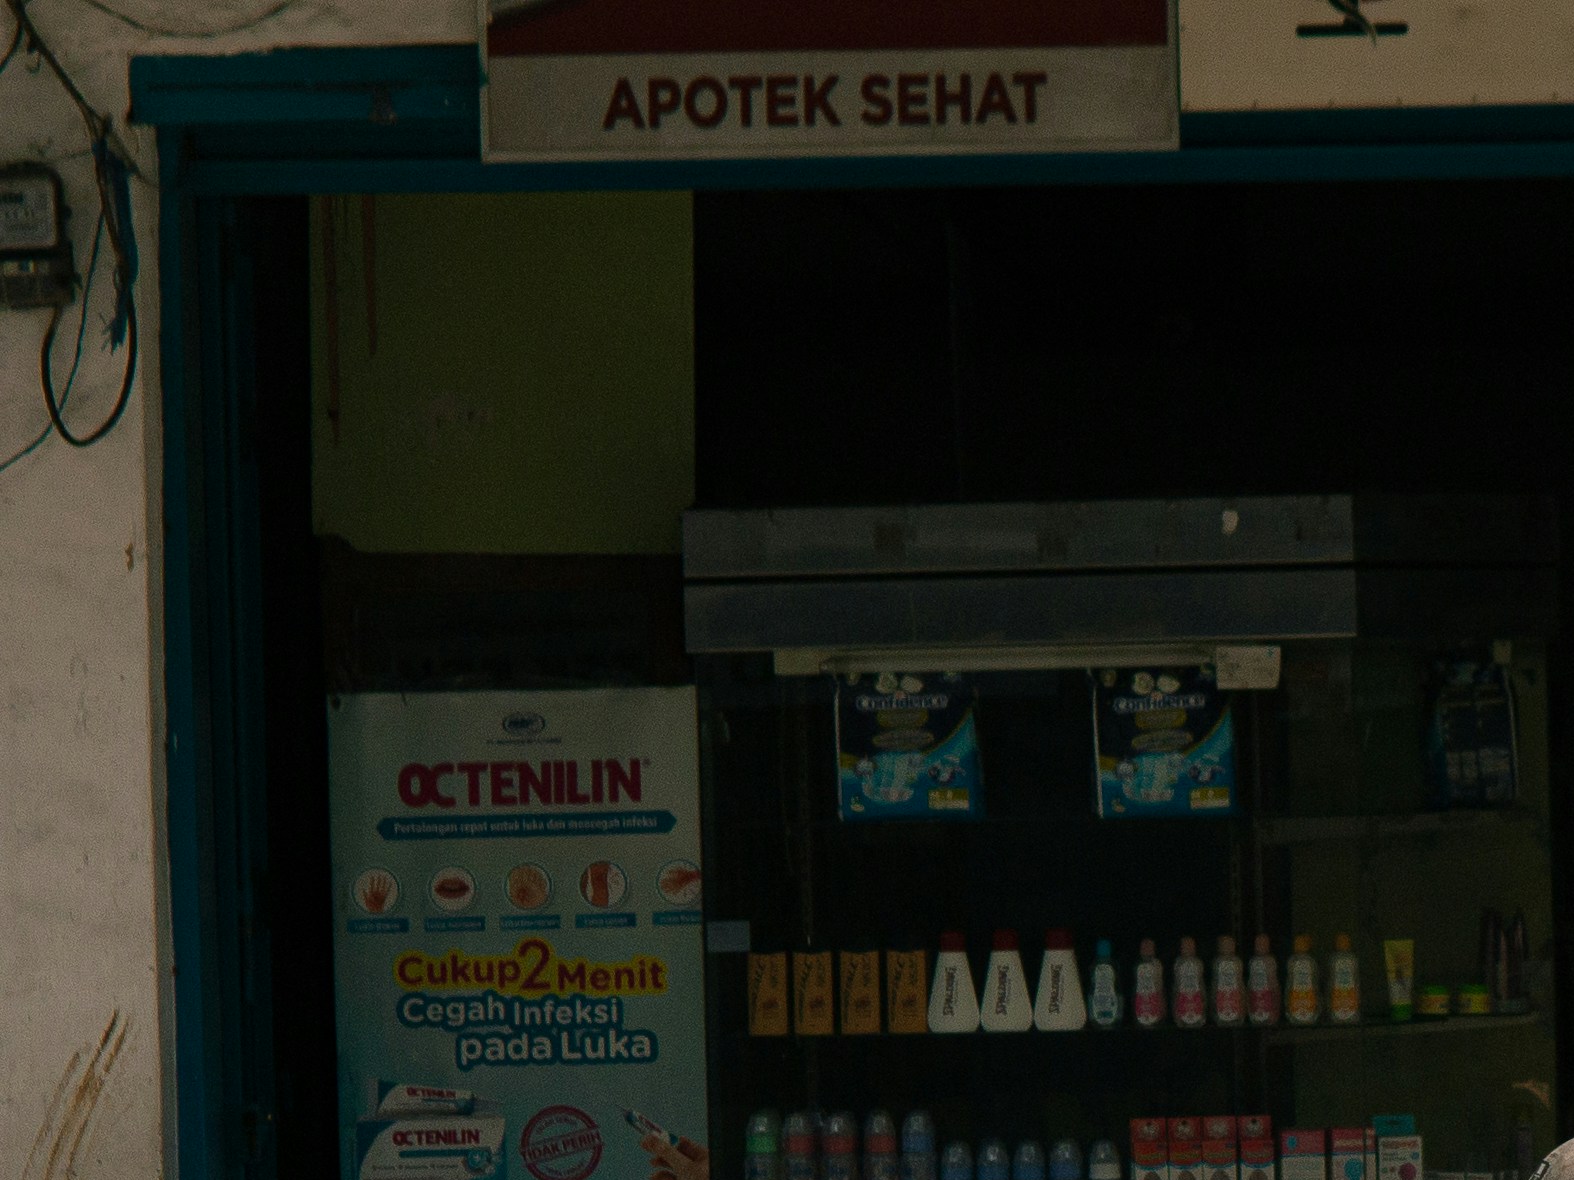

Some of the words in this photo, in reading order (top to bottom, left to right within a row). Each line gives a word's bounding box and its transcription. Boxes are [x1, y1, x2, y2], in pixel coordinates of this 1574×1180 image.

[603, 74, 841, 130] APOTEK
[859, 72, 1048, 124] SEHAT
[398, 758, 642, 809] OCTENILIN
[397, 955, 520, 990] Cukup
[519, 940, 551, 991] 2
[557, 956, 666, 990] Menit
[402, 996, 506, 1033] Cegah
[514, 996, 618, 1025] Infeksi
[461, 1030, 552, 1066] pada
[562, 1030, 653, 1060] Luka
[406, 1087, 456, 1098] OCTENILIN
[392, 1129, 480, 1146] OCTENILIN
